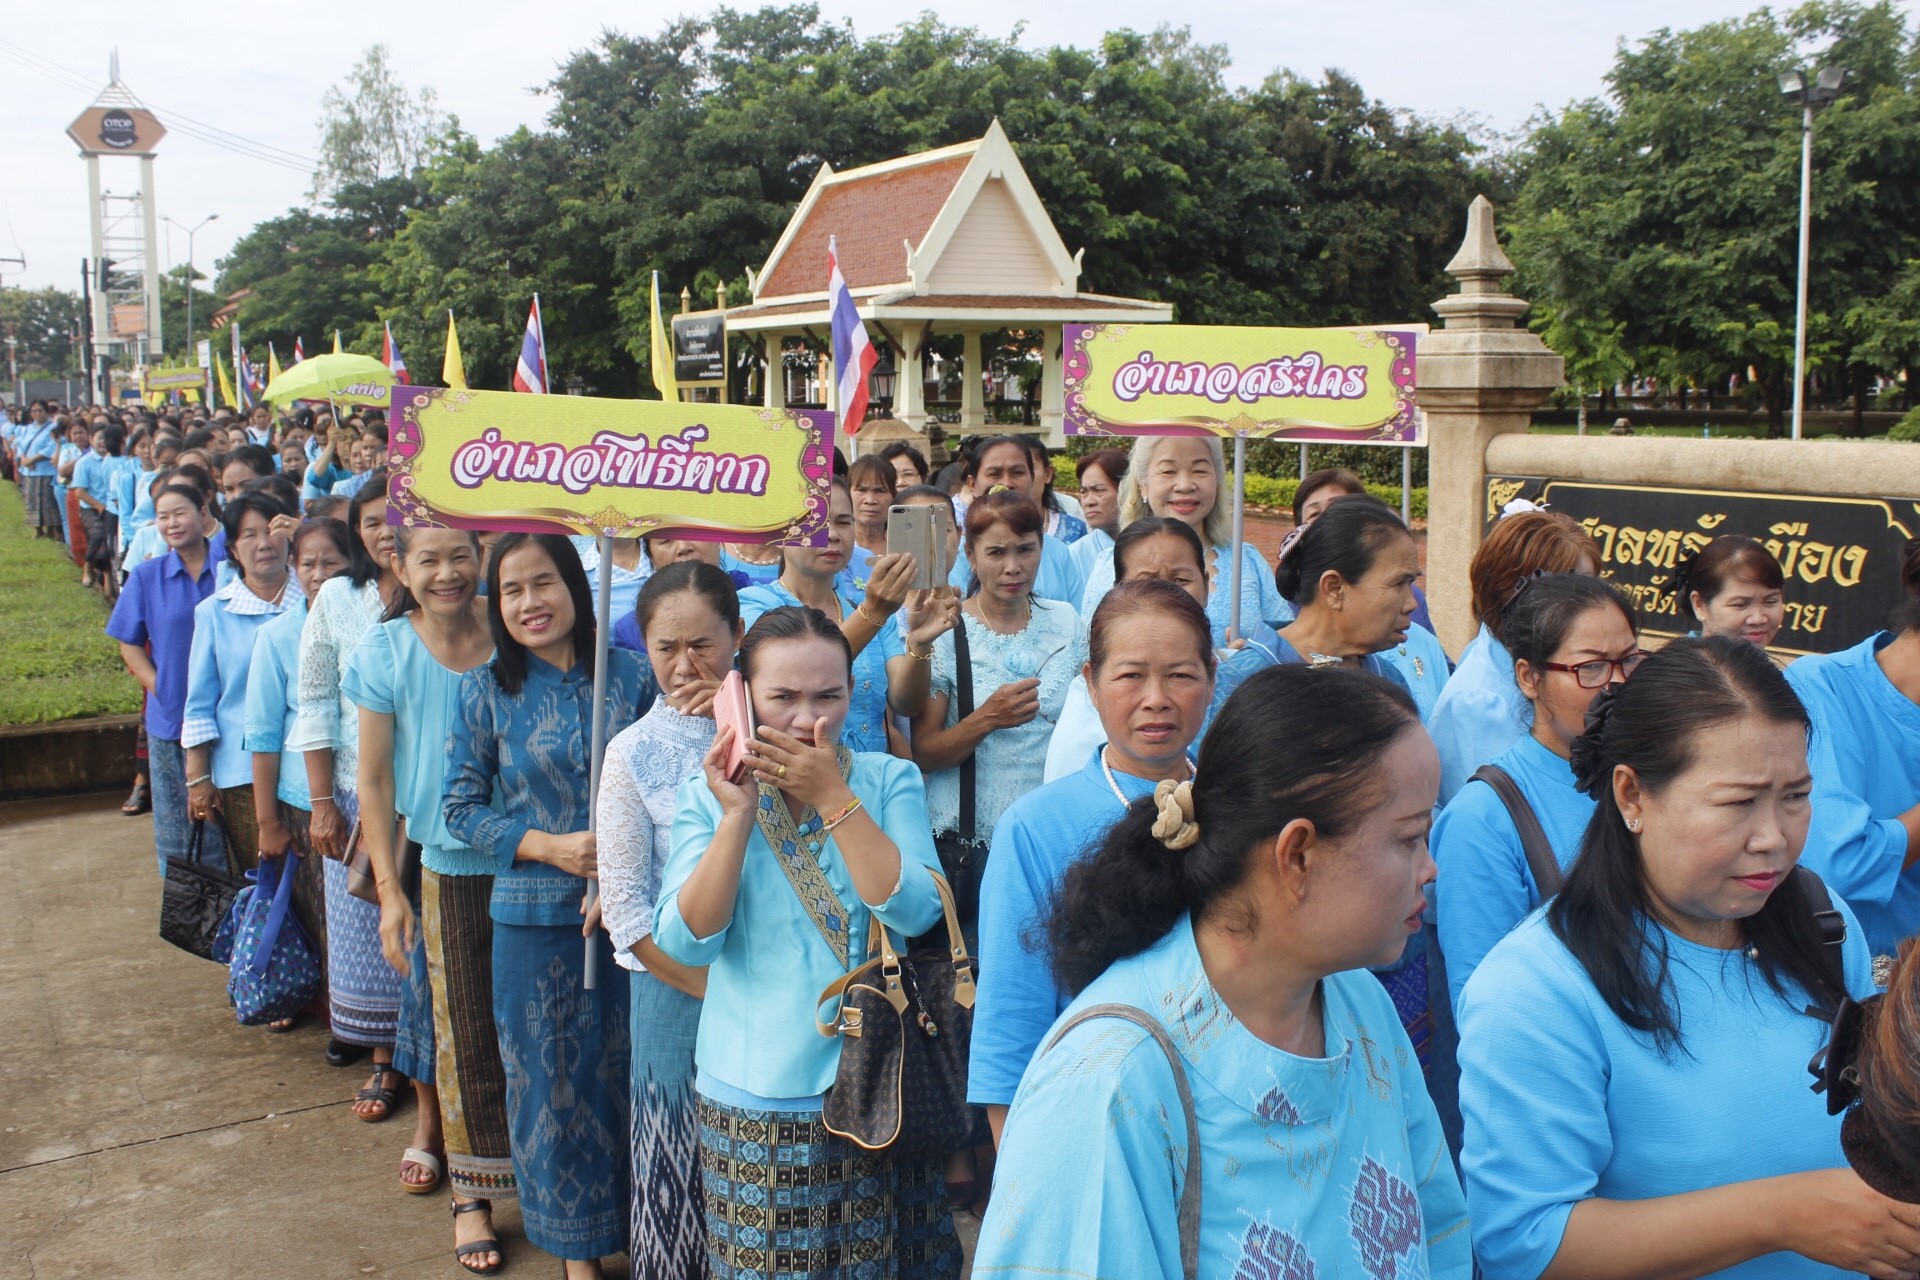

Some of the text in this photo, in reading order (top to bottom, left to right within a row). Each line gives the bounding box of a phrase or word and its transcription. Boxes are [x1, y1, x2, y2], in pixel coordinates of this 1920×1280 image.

[103, 118, 133, 128] OTOP
[1113, 350, 1368, 403] อำเภอสระใคร
[450, 423, 771, 496] อำเภอโพธิ์ตาก
